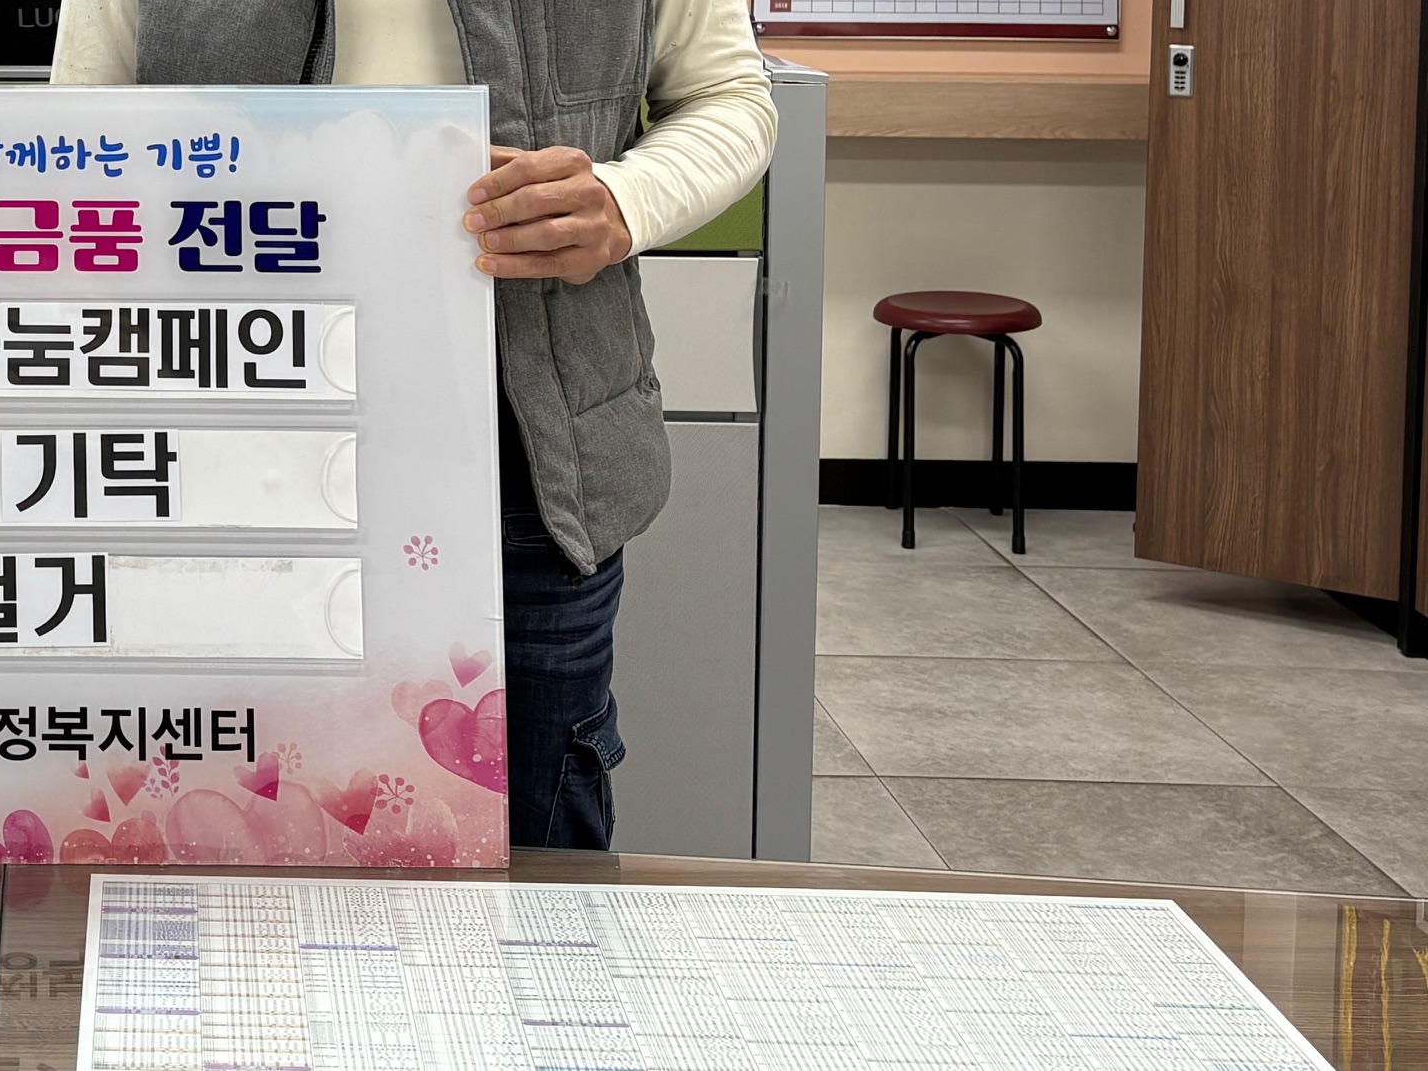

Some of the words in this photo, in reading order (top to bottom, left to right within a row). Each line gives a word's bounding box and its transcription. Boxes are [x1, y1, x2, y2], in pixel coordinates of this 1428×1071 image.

[146, 133, 241, 180] 기쁨!
[167, 195, 328, 274] 전달
[15, 430, 178, 519] 기탁
